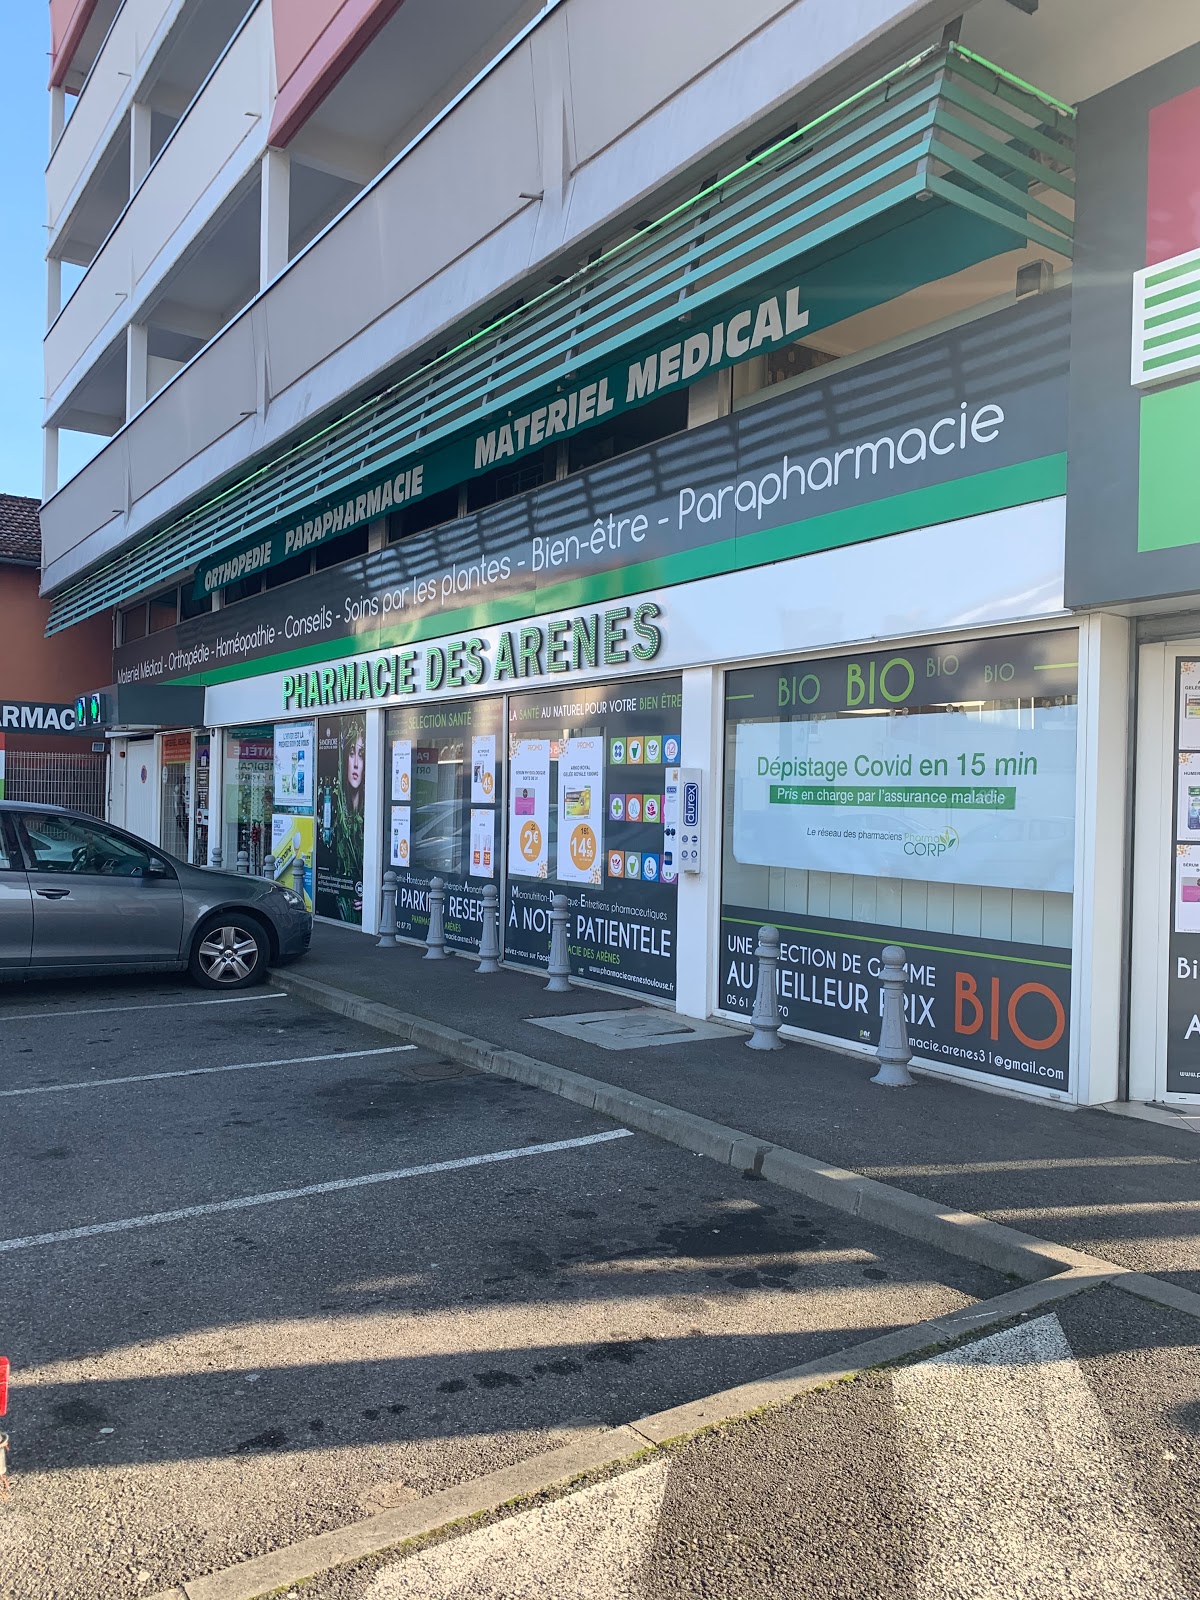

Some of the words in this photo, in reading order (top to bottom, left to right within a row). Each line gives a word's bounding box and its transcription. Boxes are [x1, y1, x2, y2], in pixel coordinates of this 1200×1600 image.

[204, 540, 272, 591] ORTHOPEDIE
[284, 464, 424, 555] PARAPHARMACIE
[474, 376, 614, 470] MATERIEL
[626, 286, 810, 403] MEDICAL
[140, 656, 164, 679] Médical
[168, 645, 210, 672] Orthopédie
[216, 624, 275, 658] Homéopathie
[284, 604, 332, 639] Conseils
[344, 596, 379, 624] Soins
[382, 586, 408, 620] par
[413, 576, 437, 605] les
[441, 554, 511, 606] plantes
[532, 512, 649, 572] Bien-être
[678, 401, 1005, 530] Parapharmacie
[282, 651, 418, 711] PHARMACIE
[425, 638, 487, 692] DES
[494, 602, 662, 681] ARENES
[926, 654, 960, 678] BIO
[846, 657, 915, 706] BIO
[984, 662, 1016, 684] BIO
[778, 674, 821, 707] BIO
[0, 705, 76, 731] RMAC
[408, 713, 446, 730] SELECTION
[448, 708, 472, 726] SANTÉ
[509, 710, 518, 722] LA
[519, 705, 540, 720] SANTÉ
[540, 707, 552, 718] AU
[553, 704, 584, 718] NATUREL
[585, 702, 607, 715] POUR
[608, 698, 636, 712] VOTRE
[640, 694, 658, 710] BIEN
[661, 692, 682, 708] ÊTRE
[757, 756, 848, 782] Dépistage
[854, 754, 913, 778] Covid
[920, 758, 948, 776] en
[956, 752, 986, 776] 15
[994, 751, 1038, 776] min
[686, 786, 697, 822] durex
[777, 787, 798, 800] Pris
[801, 790, 814, 801] en
[816, 788, 854, 805] charge
[857, 790, 876, 805] par
[878, 788, 948, 804] l'assurance
[951, 790, 1006, 804] maladie
[524, 830, 539, 854] 2€
[806, 827, 816, 836] Le
[818, 828, 842, 838] réseau
[843, 829, 857, 840] des
[858, 830, 903, 842] pharmaciens
[904, 832, 940, 844] Pharma
[903, 841, 946, 857] CORP
[450, 895, 499, 926] RESER
[611, 904, 668, 921] pharmaceutiques
[509, 900, 518, 928] À
[524, 906, 571, 938] NOT
[577, 914, 672, 958] PATIENTELE
[583, 948, 595, 959] DES
[596, 949, 620, 965] ARÈNES
[728, 934, 752, 955] UNE
[842, 952, 861, 974] DE
[727, 960, 754, 989] AU
[776, 968, 868, 1014] EILLEUR
[727, 994, 736, 1005] 05
[739, 997, 748, 1008] 61
[954, 970, 1066, 1050] BIO
